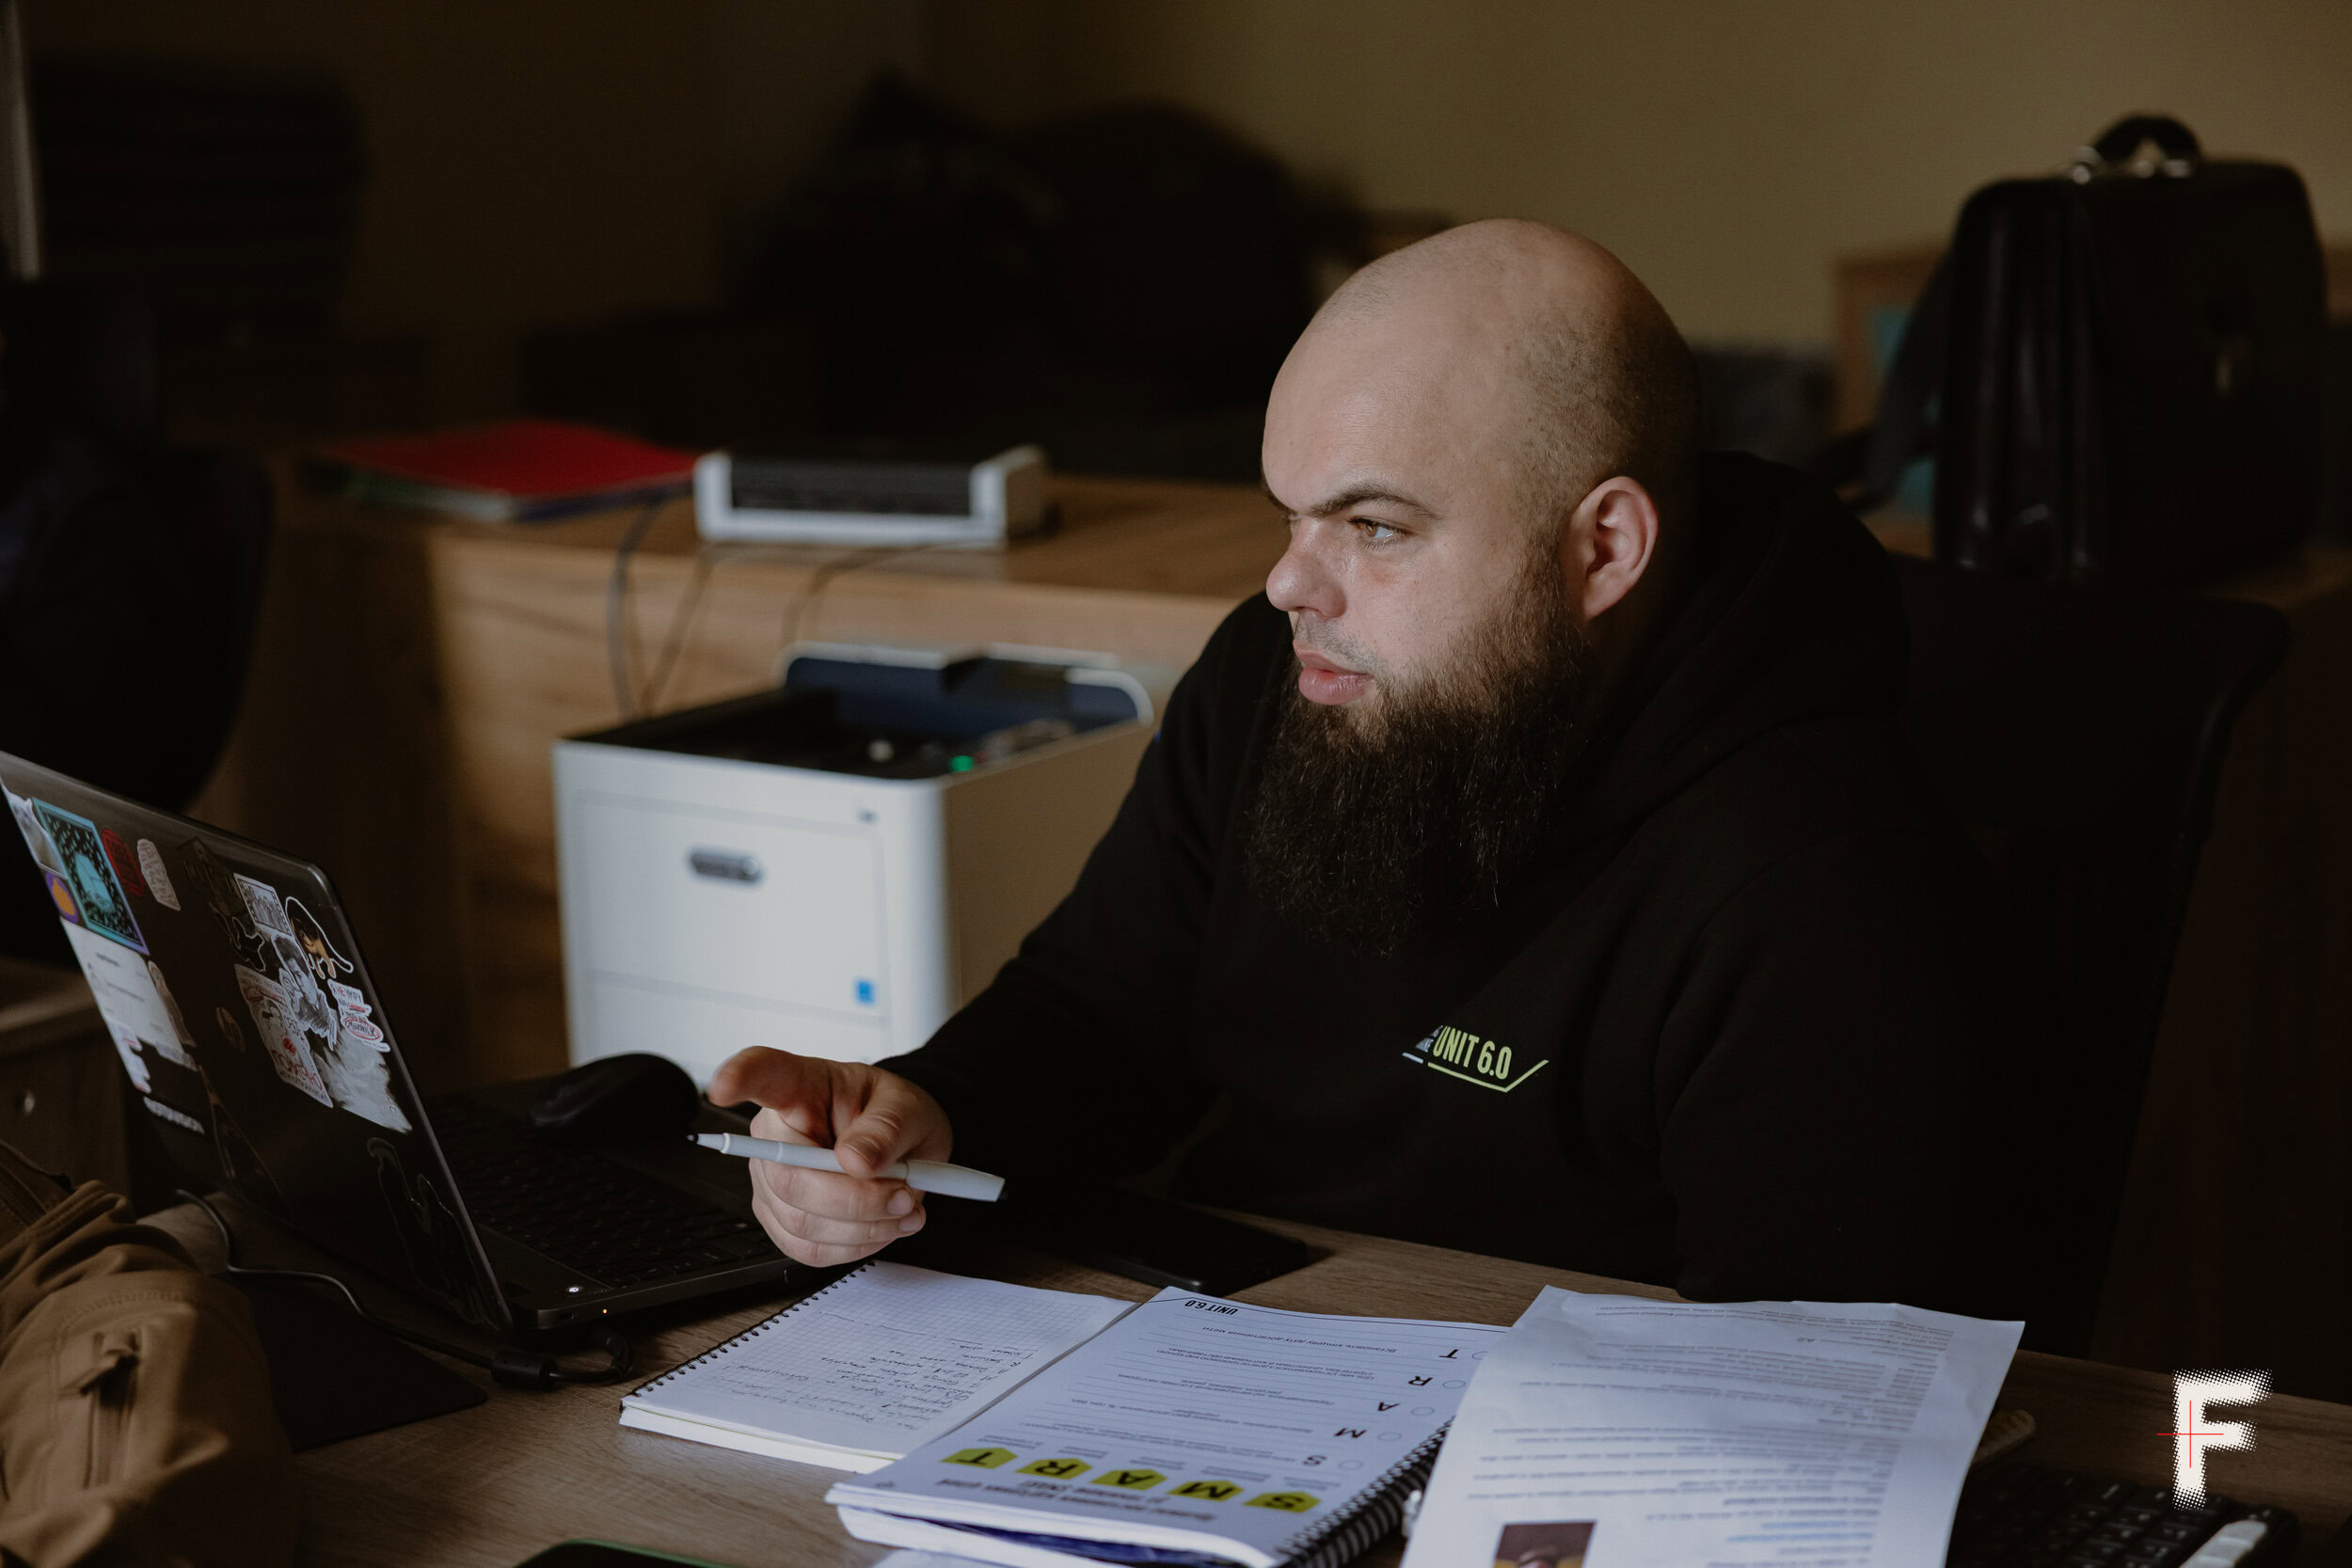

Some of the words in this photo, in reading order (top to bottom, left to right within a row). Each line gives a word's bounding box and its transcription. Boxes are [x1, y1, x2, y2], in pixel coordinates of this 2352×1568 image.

[1432, 1025, 1480, 1069] UNIT
[1477, 1040, 1513, 1080] 6.0
[1184, 1300, 1207, 1309] 6.0
[1205, 1304, 1238, 1315] UNIT
[1438, 1349, 1459, 1359] T
[1408, 1375, 1434, 1386] R
[1377, 1402, 1400, 1412] A
[1333, 1428, 1367, 1438] M
[959, 1451, 993, 1465] T
[1302, 1455, 1327, 1466] S
[1034, 1462, 1081, 1477] R
[1117, 1470, 1156, 1486] A
[1182, 1481, 1235, 1498] M
[1264, 1495, 1305, 1510] S
